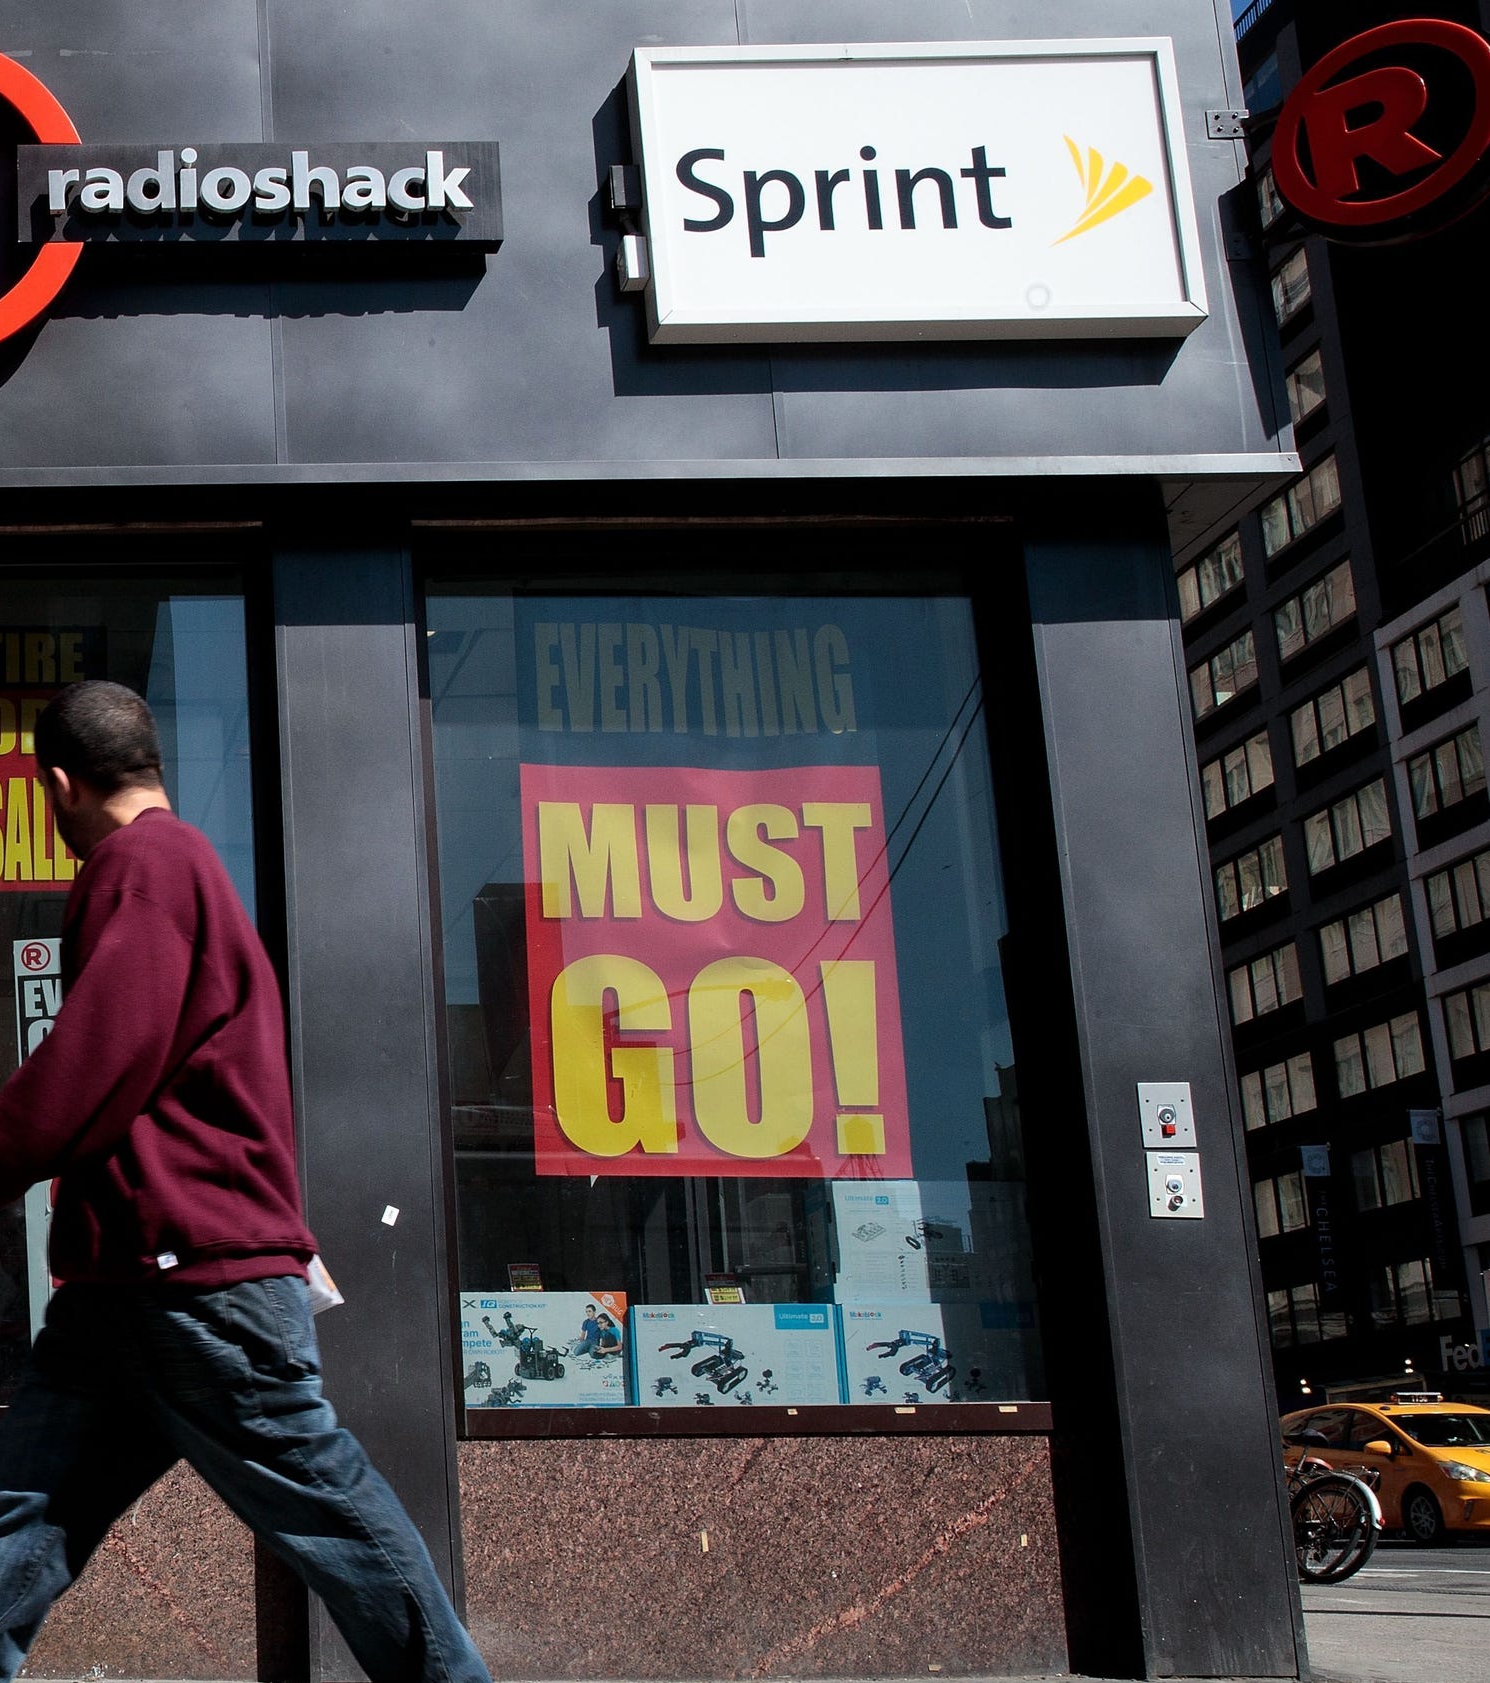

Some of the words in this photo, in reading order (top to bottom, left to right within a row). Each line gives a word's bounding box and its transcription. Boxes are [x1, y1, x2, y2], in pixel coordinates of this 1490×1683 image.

[48, 147, 474, 214] radioshack
[675, 144, 1013, 258] Sprint
[534, 622, 858, 738] EVERYTHING
[538, 801, 873, 923] MUST
[551, 954, 886, 1159] GO!
[1316, 1207, 1339, 1294] CHELSEA
